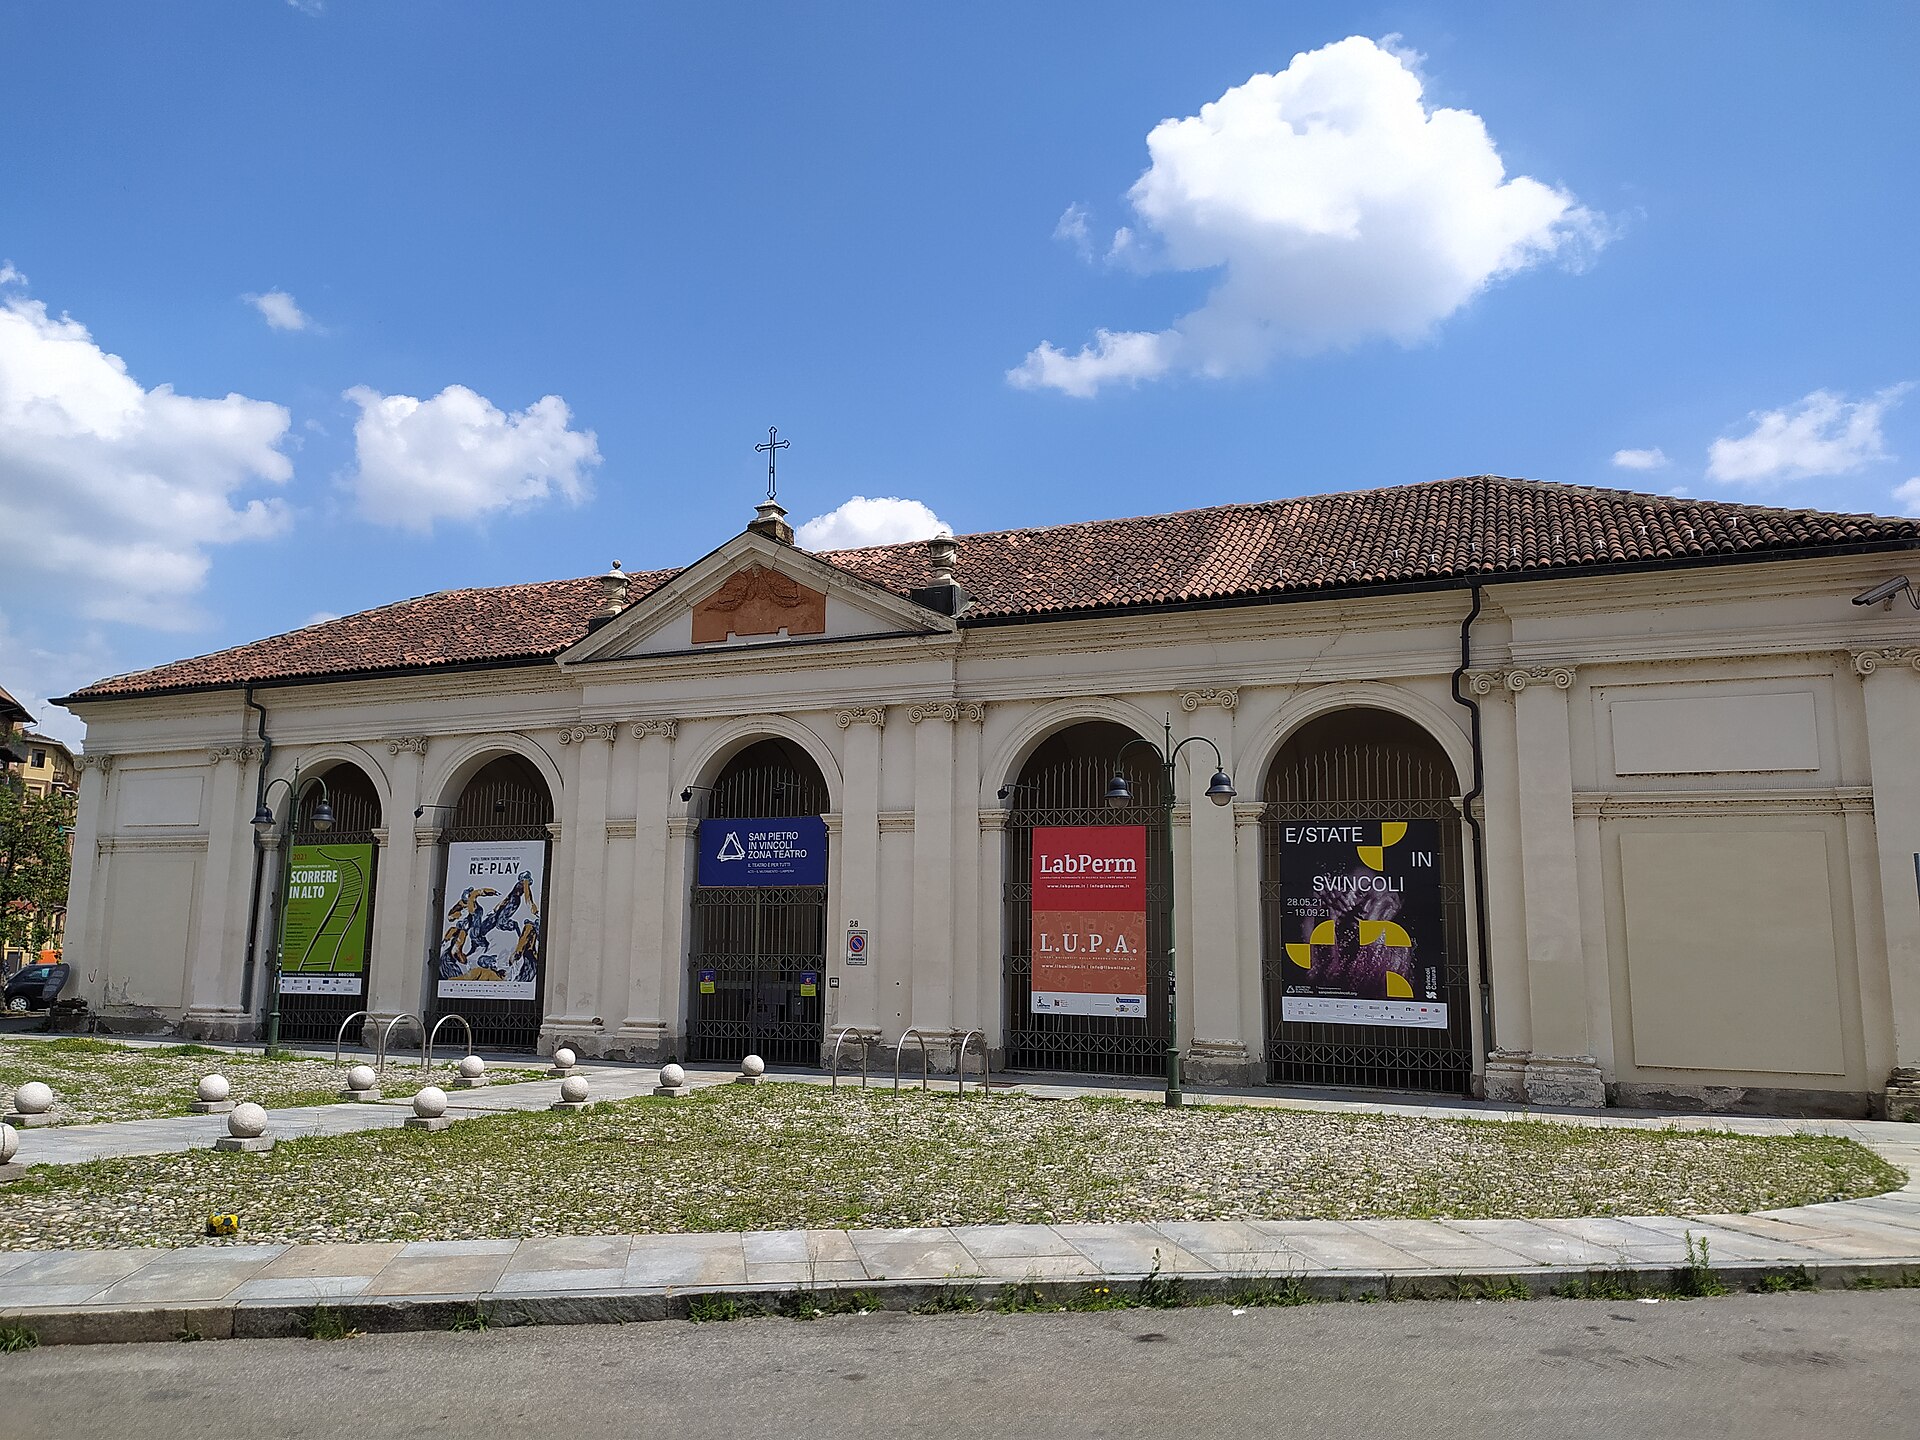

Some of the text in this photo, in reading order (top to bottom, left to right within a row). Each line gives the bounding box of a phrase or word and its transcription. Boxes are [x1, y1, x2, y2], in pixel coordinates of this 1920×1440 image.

[748, 831, 799, 841] SAN PIETRO
[1285, 826, 1364, 845] E/STATE
[748, 841, 793, 850] IN VINCOLI
[292, 853, 308, 861] 2021
[747, 849, 808, 859] ZONA TEATRO
[1411, 851, 1432, 868] IN
[469, 862, 520, 875] RE-PLAY
[1040, 854, 1137, 873] LabPerm
[290, 870, 338, 884] SCORRERE
[1312, 875, 1405, 892] SVINCOLI
[288, 885, 325, 899] IN ALTO
[1286, 898, 1323, 907] 28.05.21
[1295, 909, 1330, 917] 19.09.21
[849, 920, 859, 928] 28
[1039, 933, 1137, 954] L.U.P.A.
